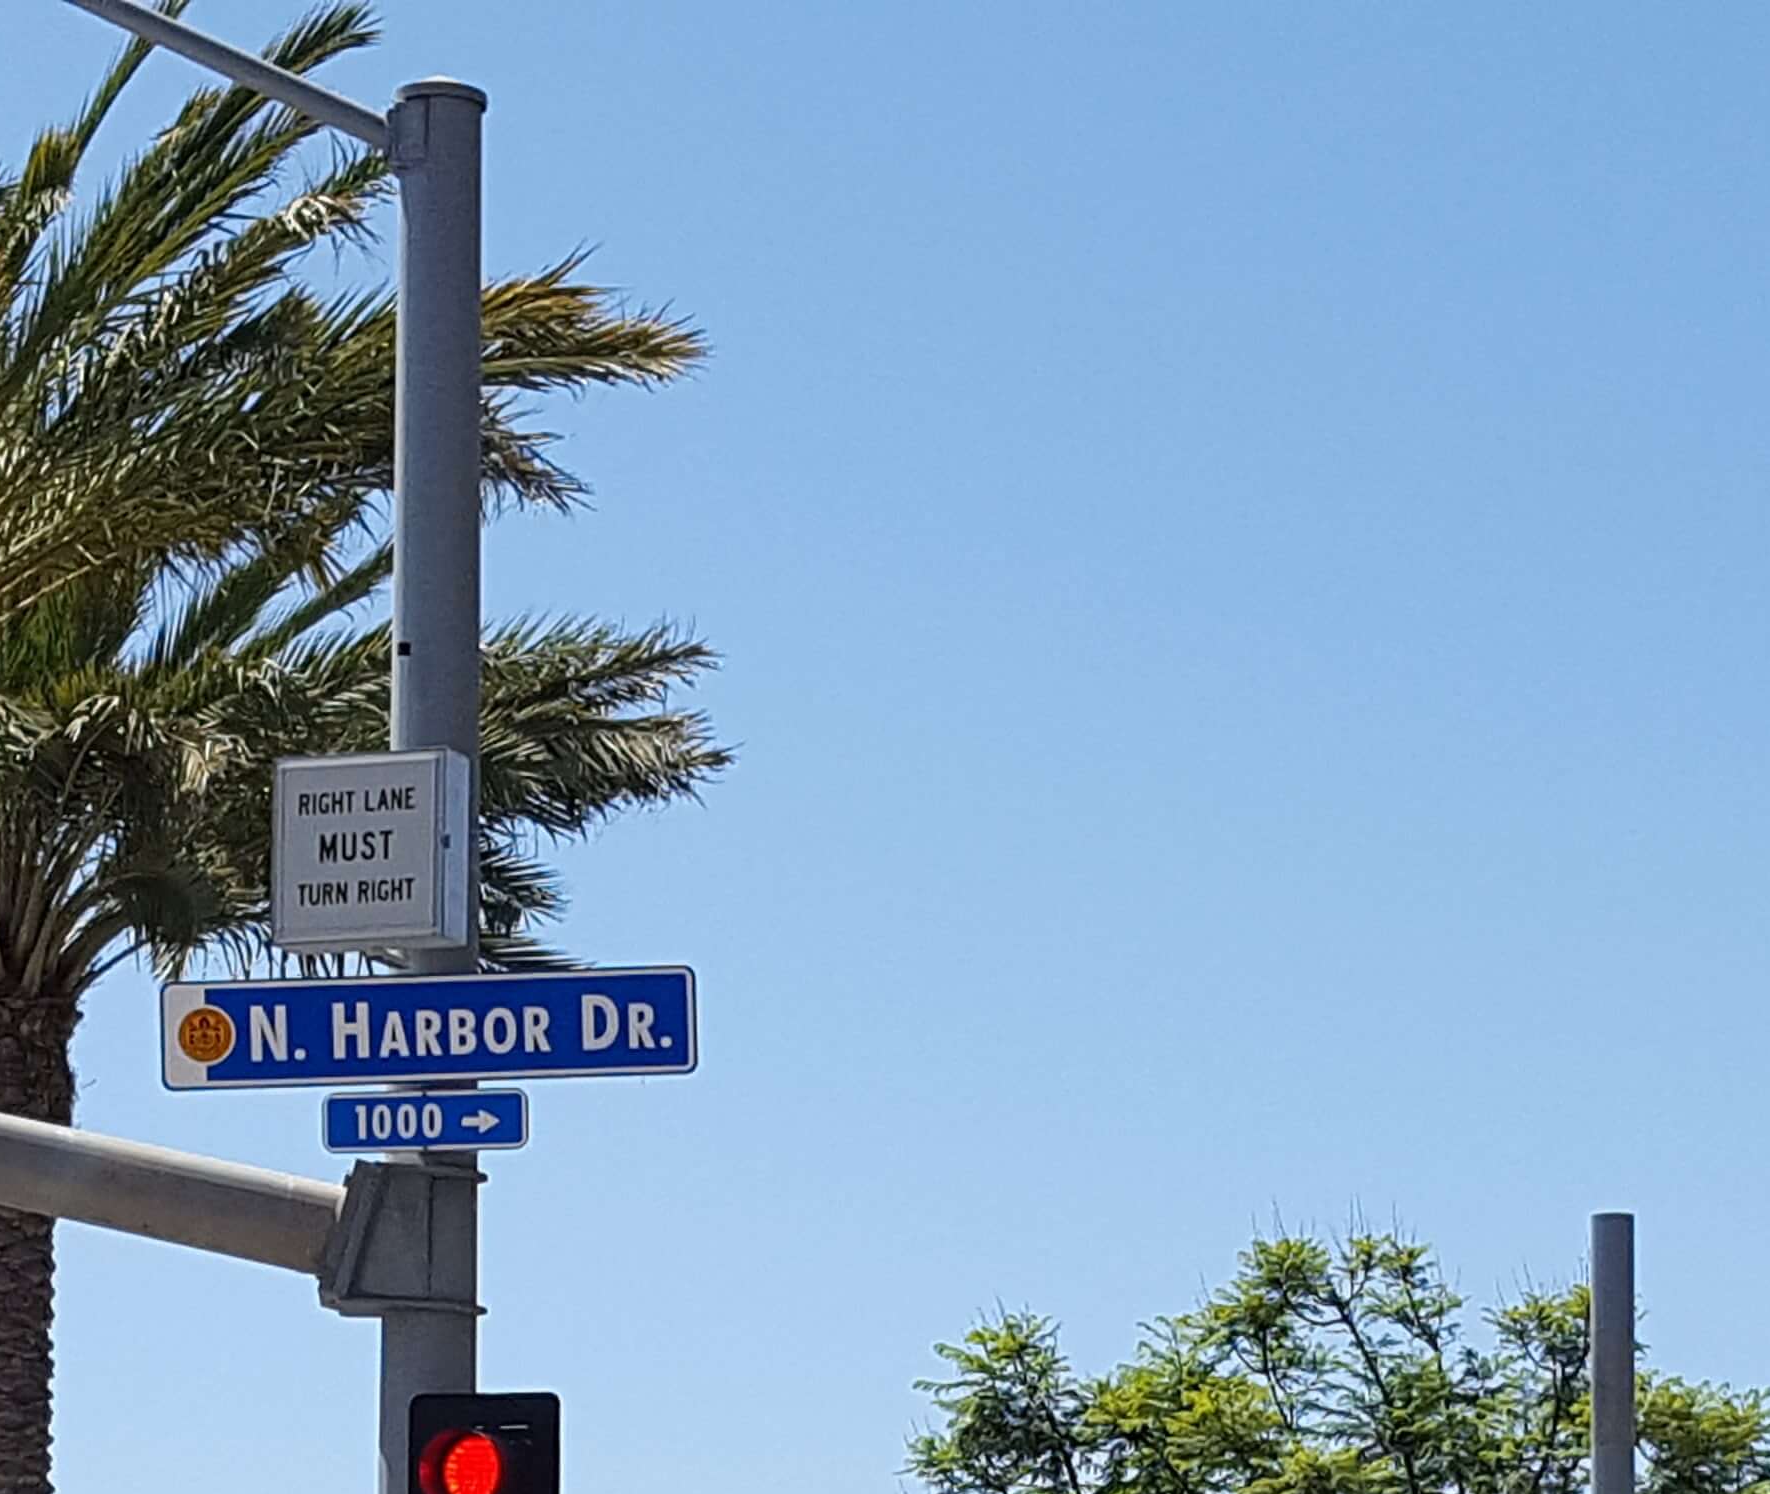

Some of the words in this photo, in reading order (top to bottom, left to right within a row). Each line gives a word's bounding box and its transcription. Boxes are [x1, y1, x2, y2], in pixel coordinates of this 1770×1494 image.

[298, 791, 355, 816] RIGHT
[364, 786, 416, 812] LANE
[319, 830, 393, 864] MUST
[297, 881, 348, 907] TURN
[357, 877, 416, 904] RIGHT
[249, 1004, 307, 1062] N.
[331, 1001, 552, 1060] HARBOR
[580, 993, 673, 1051] DR.
[354, 1102, 444, 1141] 1000
